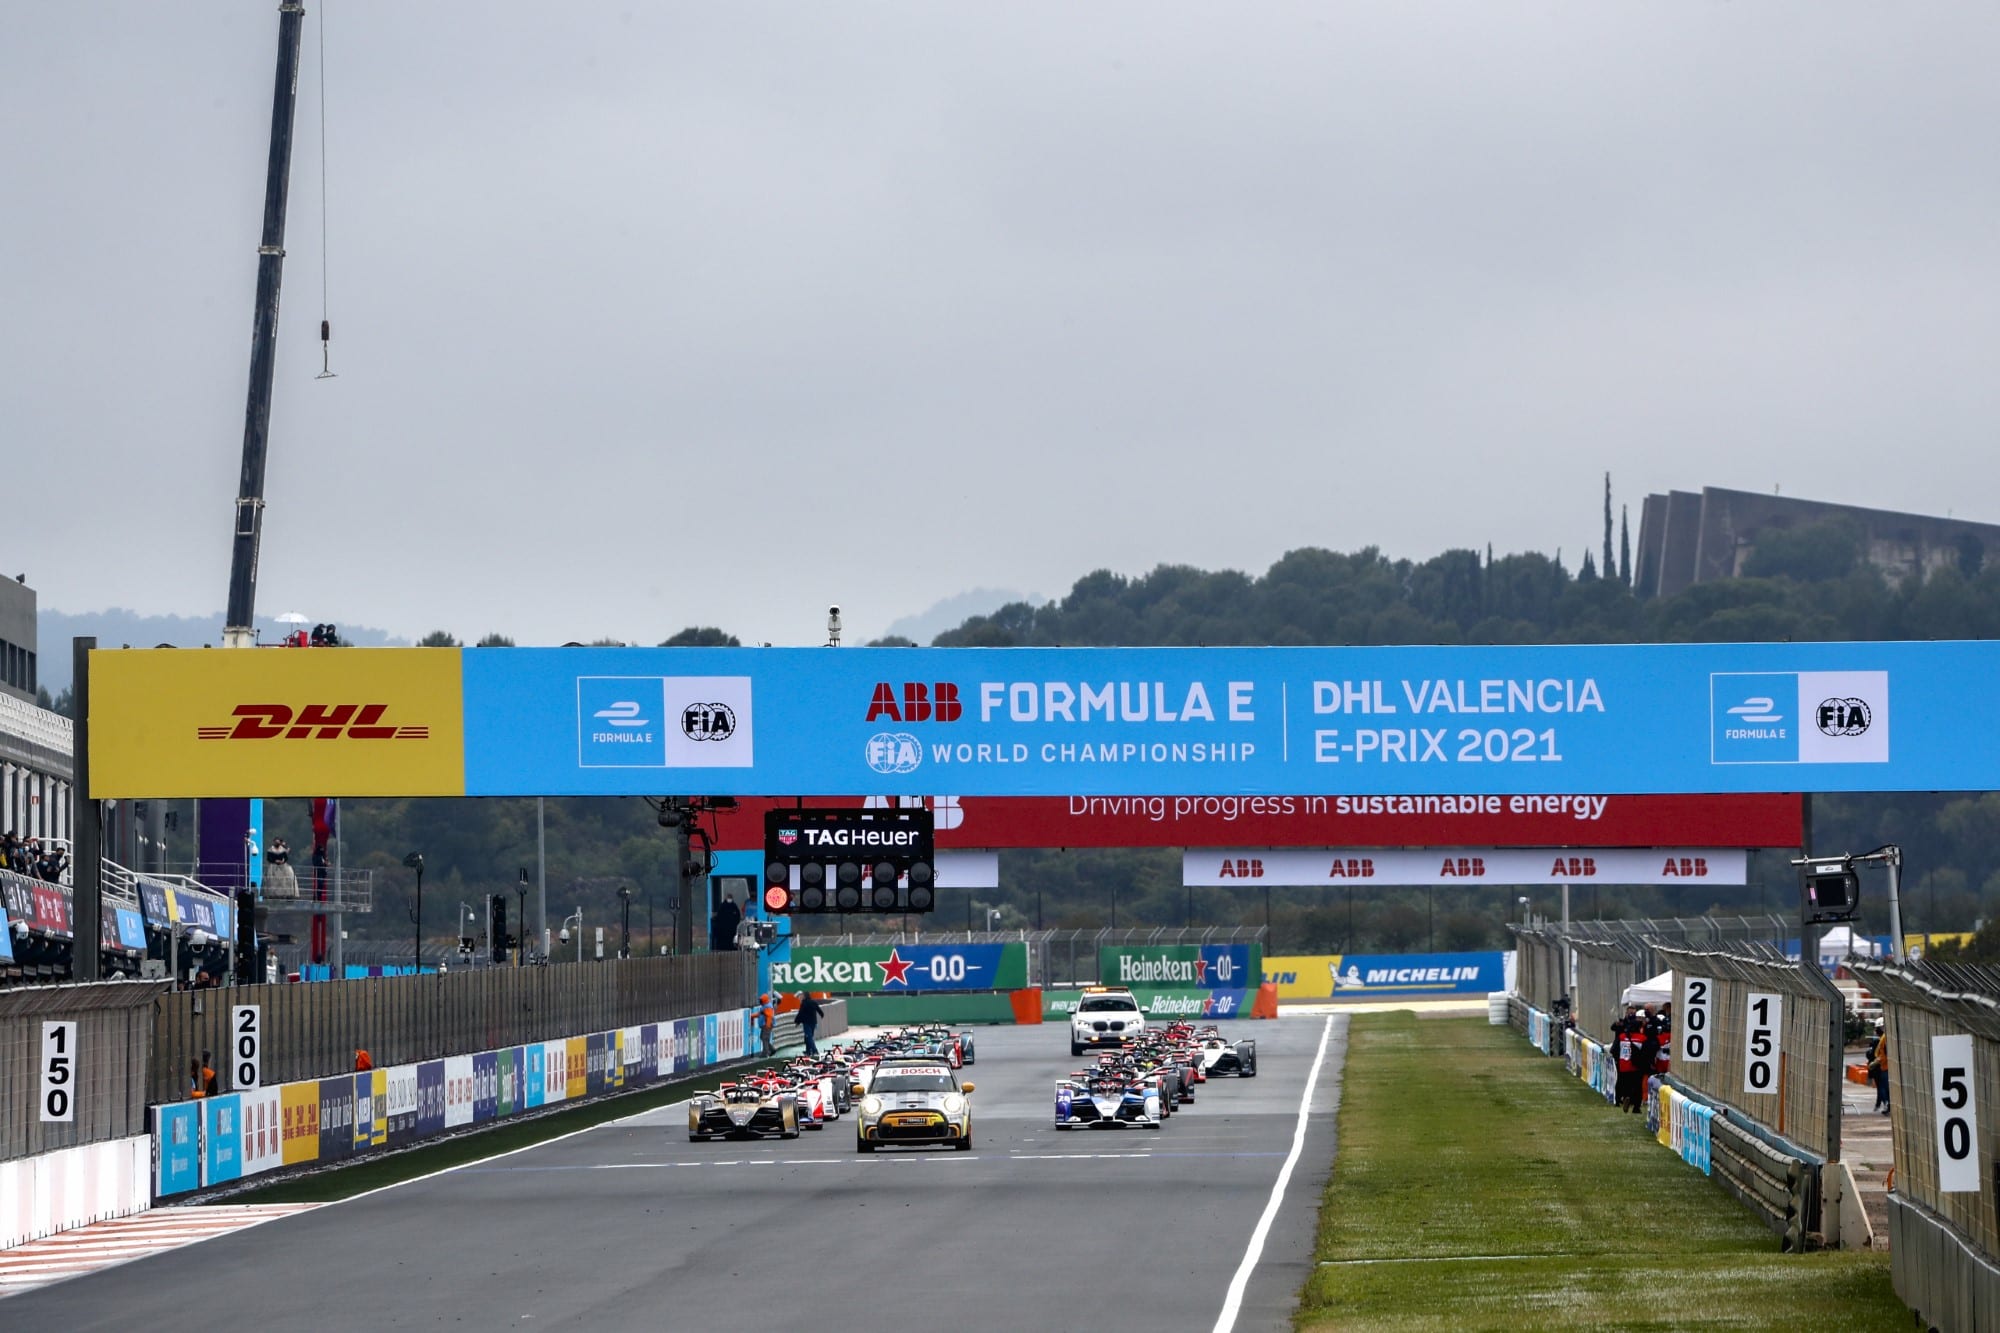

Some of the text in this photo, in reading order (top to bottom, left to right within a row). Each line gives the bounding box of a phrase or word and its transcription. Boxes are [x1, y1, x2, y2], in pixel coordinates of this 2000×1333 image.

[865, 682, 1254, 722] ABB FORMULA E
[1314, 679, 1605, 714] DHL VALENCIA
[229, 704, 399, 739] DHL
[1726, 729, 1786, 739] FORMULA E
[593, 733, 652, 743] FORMULA E
[1315, 729, 1562, 762] E-PRIX 2021
[933, 744, 1028, 763] WORLD
[1041, 743, 1255, 762] CHAMPIONSHIP
[1069, 796, 1165, 821] Driving
[1175, 797, 1295, 820] progress
[1336, 796, 1501, 815] sustainable
[1509, 796, 1608, 820] energy
[1219, 859, 1264, 878] ABB
[1329, 859, 1375, 877] ABB
[1440, 858, 1485, 877] ABB
[1551, 858, 1597, 876] ABB
[1662, 858, 1708, 876] ABB
[773, 955, 873, 984] neken
[1119, 955, 1193, 981] Heineken
[1366, 967, 1479, 983] MICHELIN
[1150, 995, 1201, 1014] Heineken
[1686, 981, 1707, 1058] 200
[238, 1009, 256, 1086] 200
[1749, 998, 1772, 1089] 150
[47, 1026, 70, 1117] 150
[900, 1068, 942, 1077] BOSCH
[1941, 1067, 1971, 1160] 50
